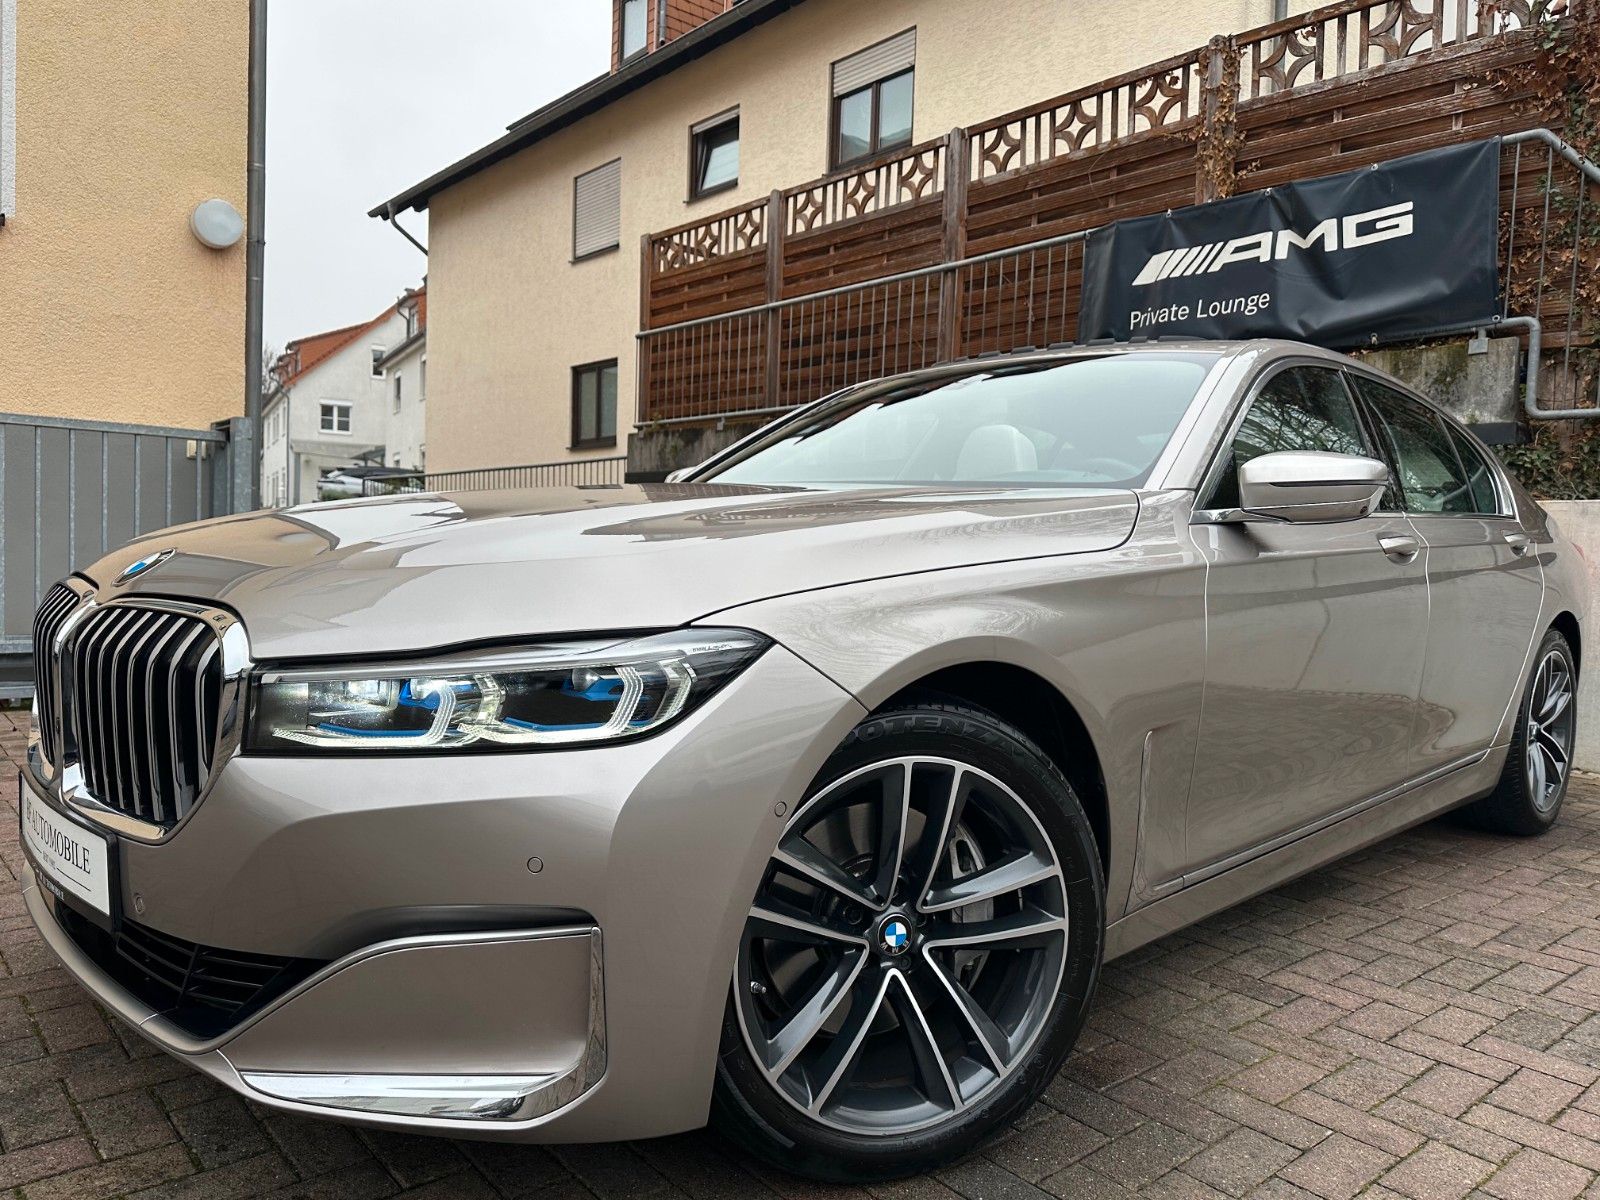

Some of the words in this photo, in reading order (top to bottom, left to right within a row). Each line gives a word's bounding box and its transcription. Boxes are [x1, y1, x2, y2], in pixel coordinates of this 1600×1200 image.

[1207, 201, 1414, 273] AMG
[1130, 305, 1190, 330] Private
[1197, 292, 1270, 319] Lounge
[846, 715, 1020, 760] OTENZA
[32, 808, 91, 875] AUTOMOBILE
